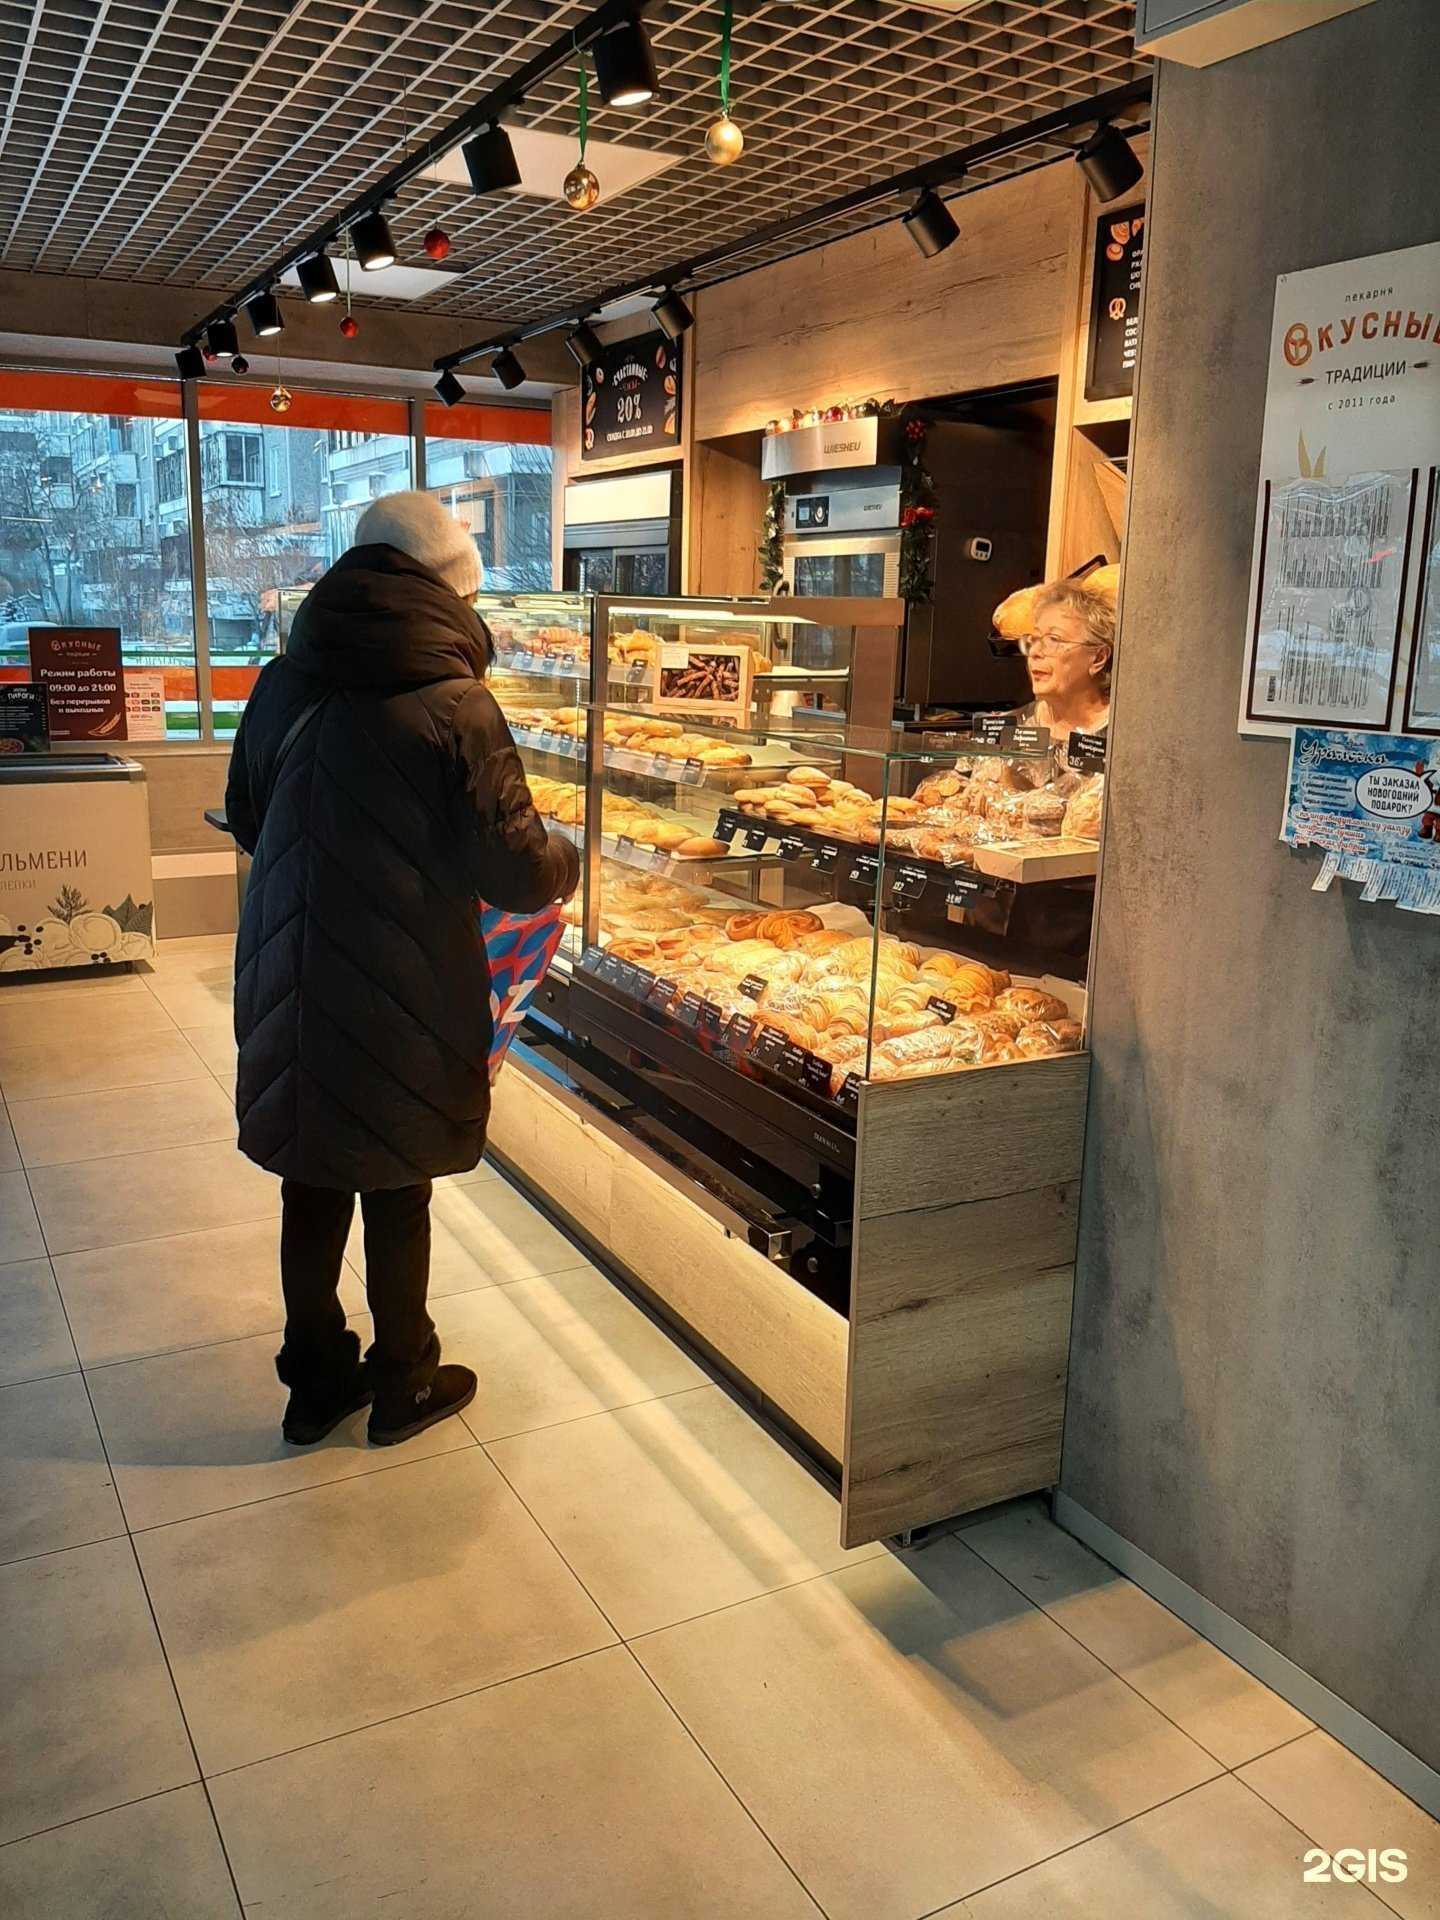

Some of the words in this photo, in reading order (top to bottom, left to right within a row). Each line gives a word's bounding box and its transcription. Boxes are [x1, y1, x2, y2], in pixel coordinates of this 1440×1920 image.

[1344, 286, 1394, 302] пекарня
[1325, 360, 1407, 385] ТРАДИЦИИ
[617, 393, 642, 423] 20%
[1338, 396, 1364, 409] 2011
[1369, 393, 1396, 407] года
[40, 668, 75, 677] Режим
[77, 668, 116, 679] работы
[49, 683, 76, 692] 09:00
[91, 683, 116, 692] 21:00
[1369, 775, 1381, 786] ТЫ
[1381, 776, 1420, 790] ЗАКАЗАЛ
[1367, 787, 1420, 801] НОВОГОДНИЙ
[1371, 800, 1413, 813] ПОДАРОК?
[0, 849, 87, 872] ЛЬМЕНИ
